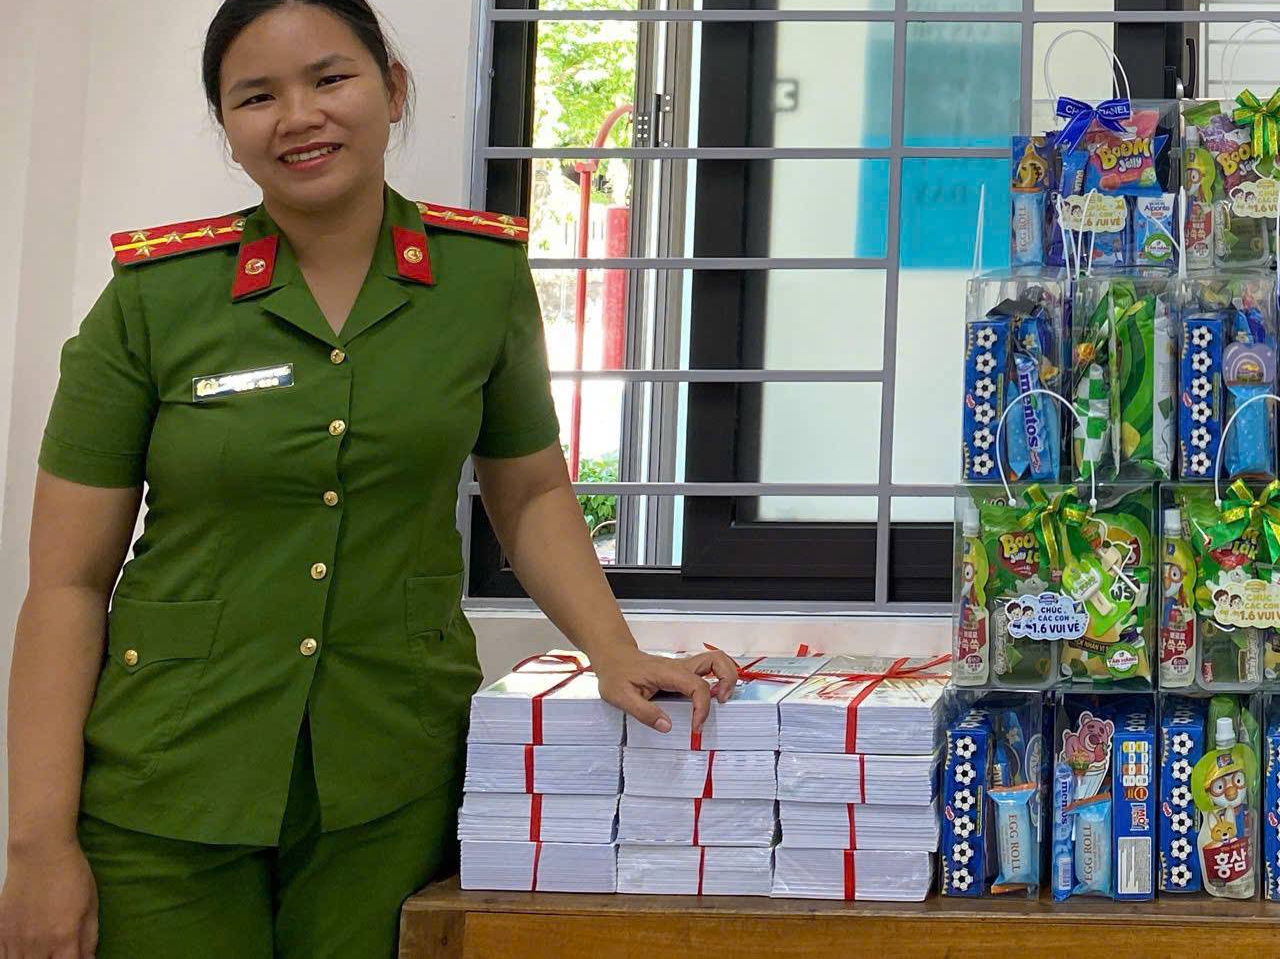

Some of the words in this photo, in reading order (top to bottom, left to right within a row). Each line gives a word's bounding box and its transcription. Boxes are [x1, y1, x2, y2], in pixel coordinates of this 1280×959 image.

[1247, 593, 1272, 602] CHÚC
[1041, 606, 1062, 614] CHÚC
[1244, 601, 1261, 609] CÁC
[1038, 614, 1053, 622] CÁC
[1239, 610, 1255, 621] 1.6
[1257, 611, 1275, 620] VUI
[1032, 622, 1047, 634] 1.6
[1049, 623, 1066, 634] VUI
[1008, 814, 1019, 838] EGG
[1083, 825, 1092, 852] ROLL
[1010, 841, 1021, 873] ROLL
[1213, 847, 1246, 879] 홍삼
[1082, 855, 1093, 882] EGG
